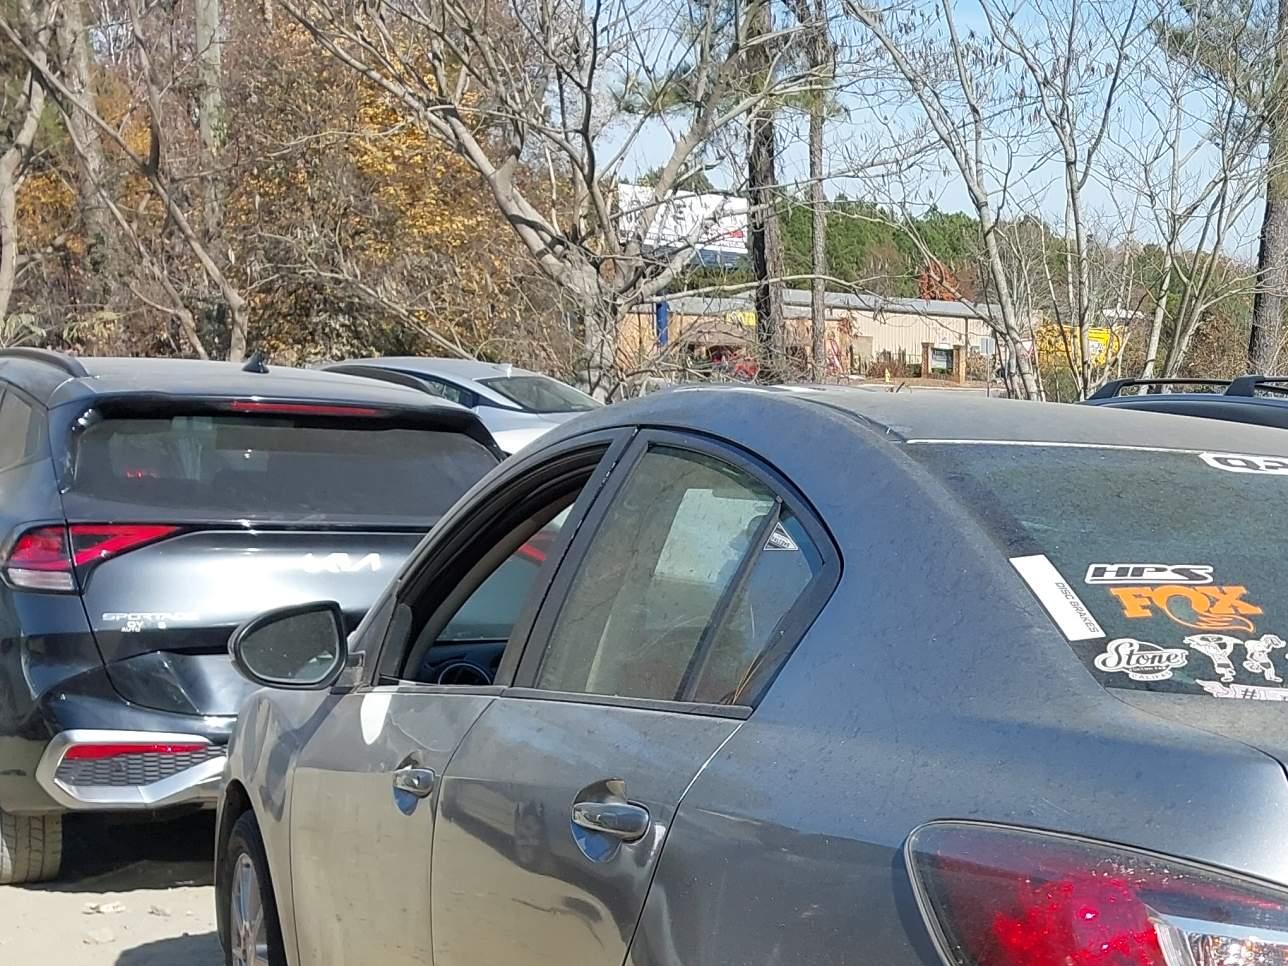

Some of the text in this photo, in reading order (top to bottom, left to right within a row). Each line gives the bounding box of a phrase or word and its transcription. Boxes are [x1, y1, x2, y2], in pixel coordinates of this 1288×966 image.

[1091, 566, 1210, 583] HPS
[1055, 582, 1099, 633] DISC BRAKES
[1109, 585, 1263, 631] FOX
